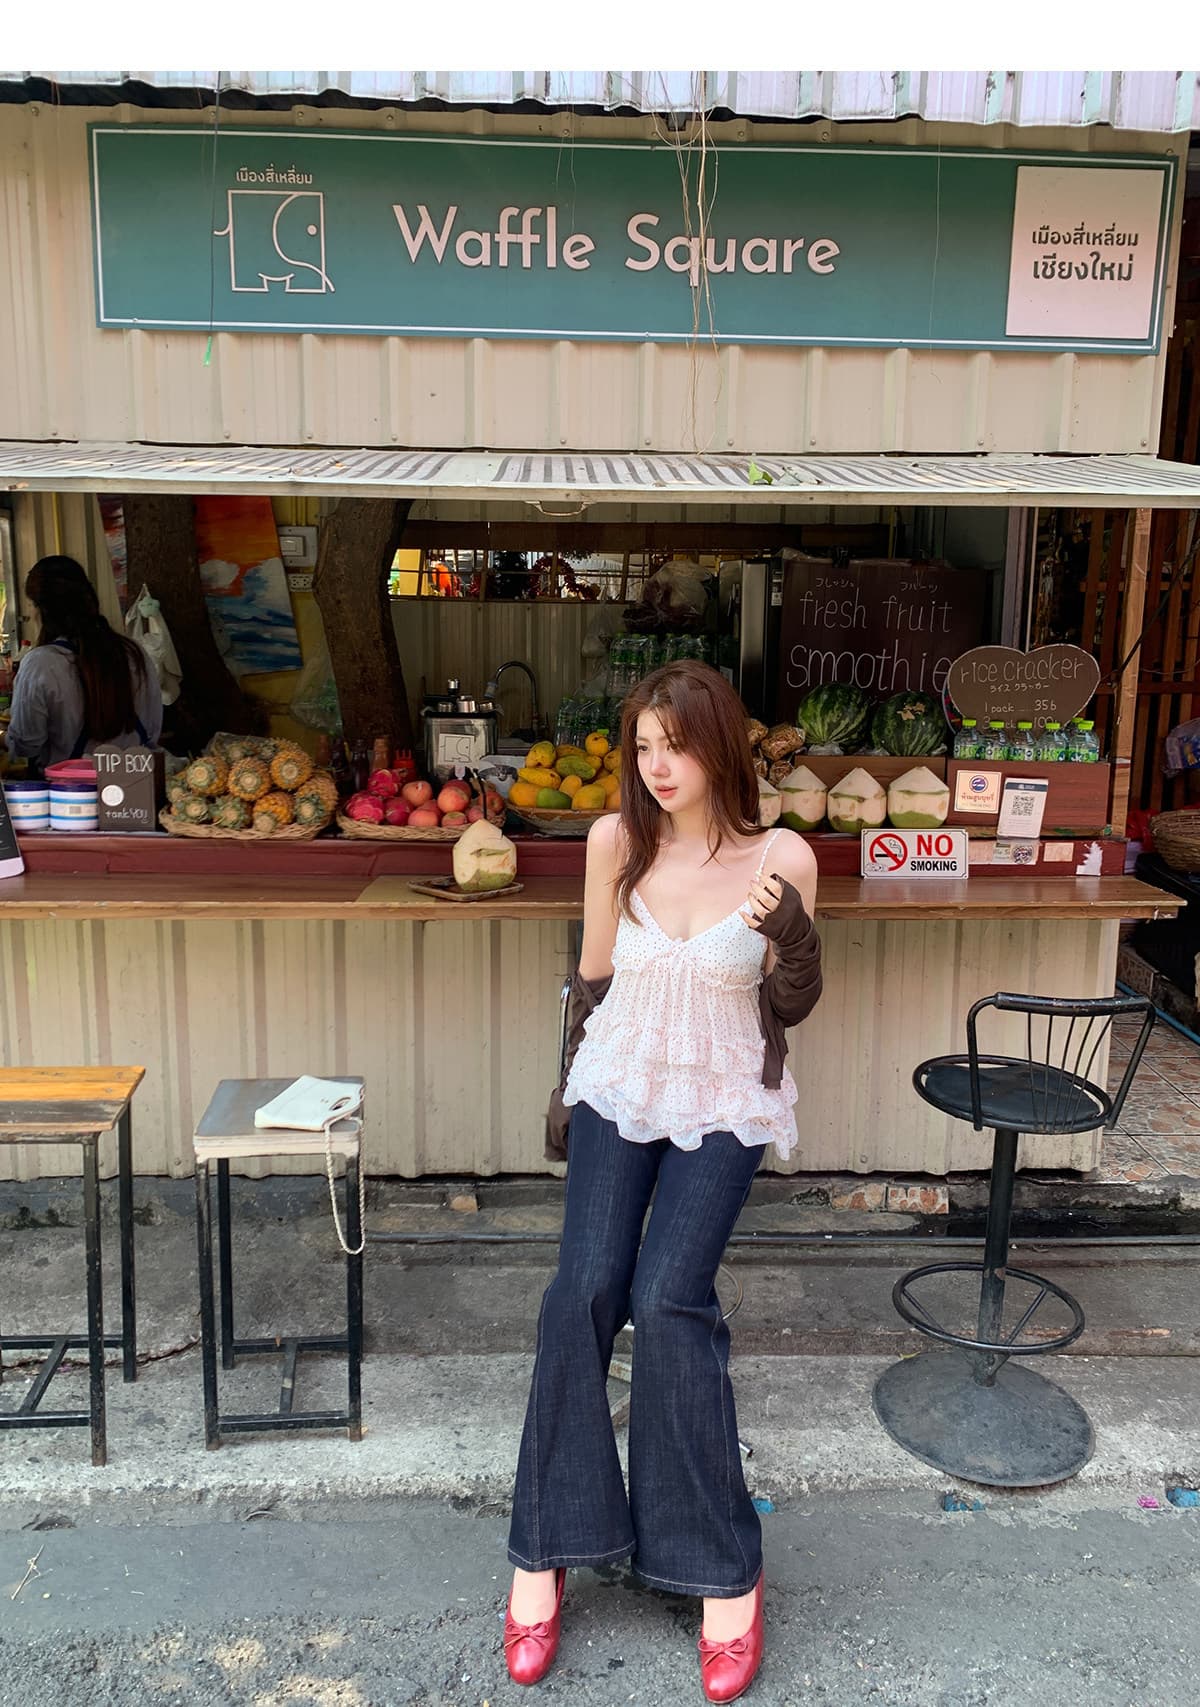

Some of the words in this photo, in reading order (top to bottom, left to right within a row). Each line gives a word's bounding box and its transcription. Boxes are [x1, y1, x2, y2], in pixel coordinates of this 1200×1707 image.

[236, 163, 313, 184] เมืองสี่เหลี่ยม
[392, 204, 595, 270] Waffle
[625, 213, 841, 287] Square
[1032, 221, 1139, 246] เมืองสี่เหลี่ยม
[1033, 251, 1134, 281] เชียงใหม่
[800, 587, 867, 629] fresh
[882, 595, 953, 632] fruit
[787, 639, 952, 692] smoothie
[1003, 653, 1084, 681] cracker
[991, 703, 1015, 714] pack
[94, 753, 121, 773] TIP
[125, 754, 152, 773] BOX
[917, 834, 953, 856] NO
[910, 860, 957, 872] SMOKING
